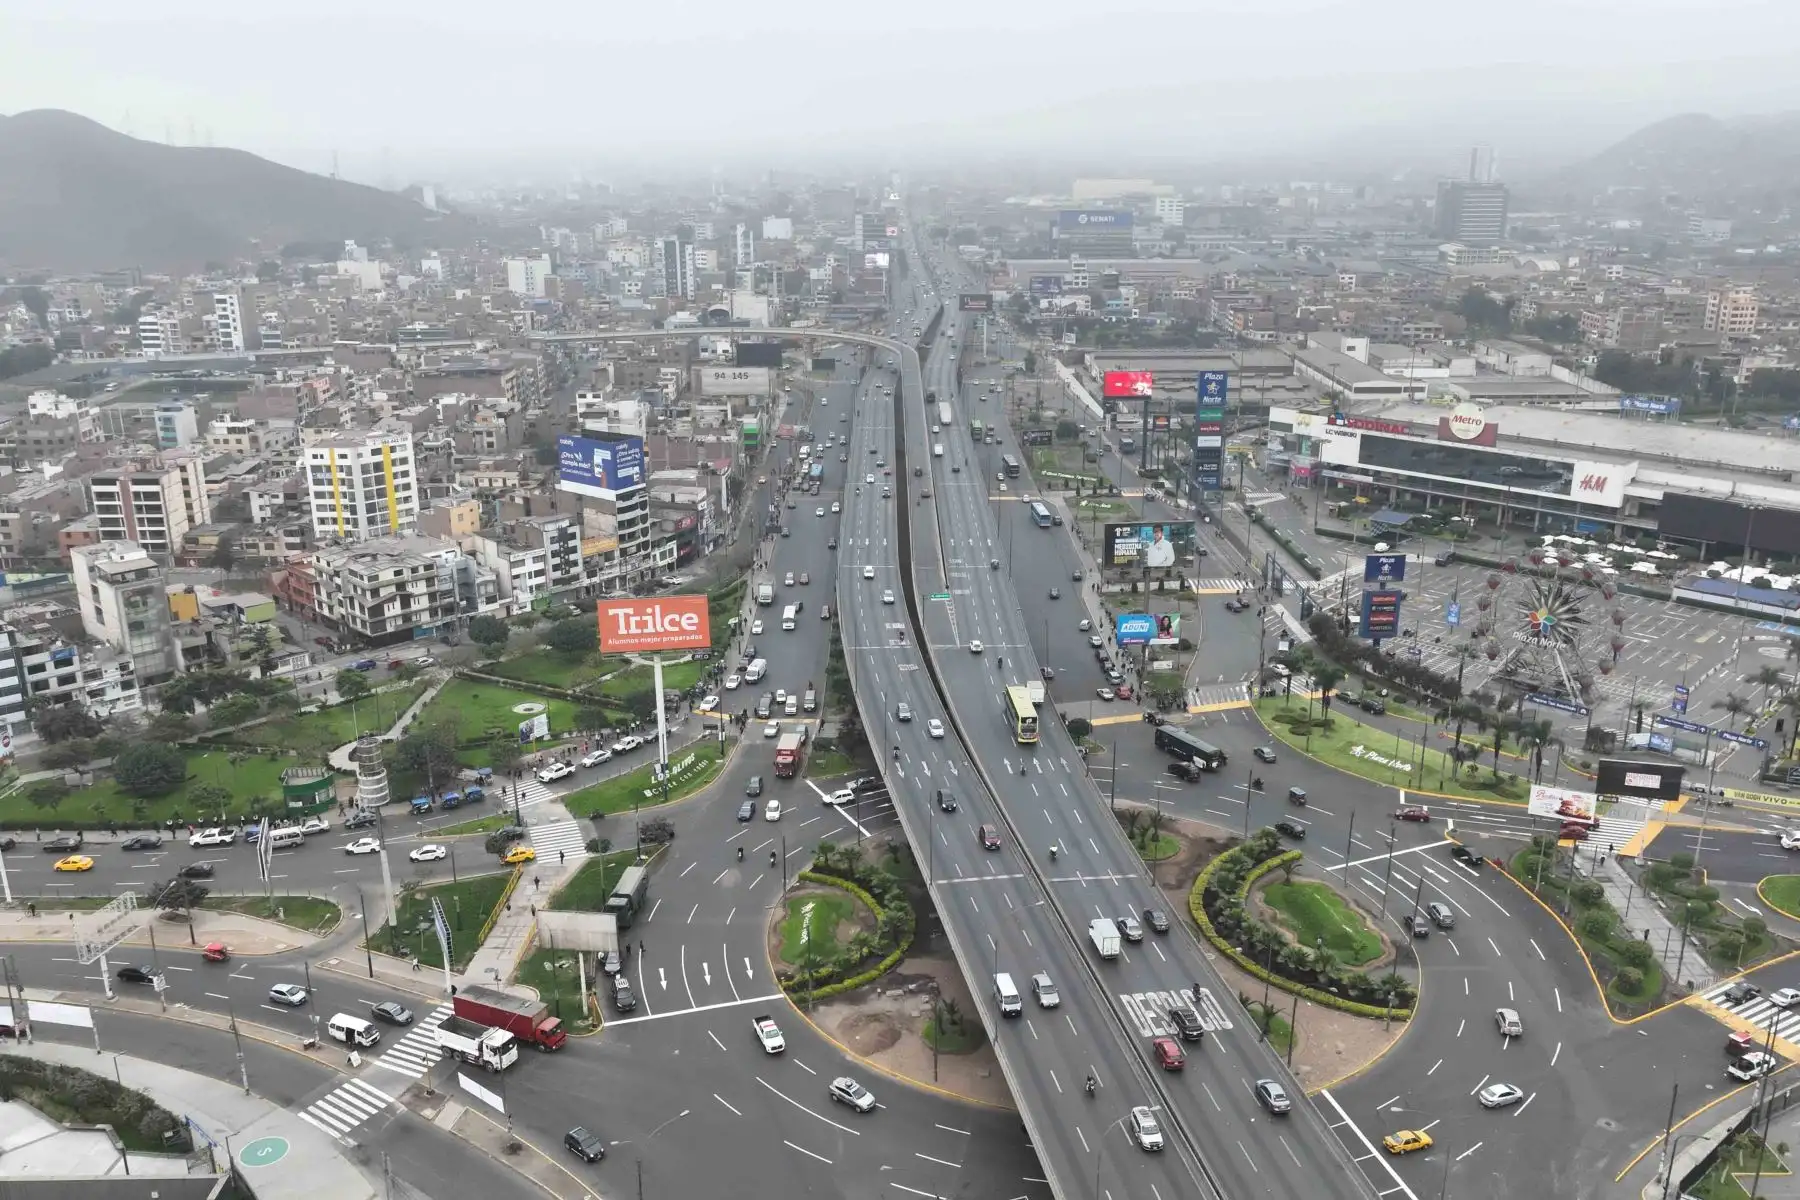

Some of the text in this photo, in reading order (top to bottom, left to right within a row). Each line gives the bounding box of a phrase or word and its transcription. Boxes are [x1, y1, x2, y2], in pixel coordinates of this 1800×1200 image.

[1202, 396, 1222, 404] Norte
[1452, 415, 1482, 426] Metro
[1579, 474, 1608, 493] H&M
[608, 604, 699, 635] Trilce
[1123, 623, 1149, 632] ADUNI
[608, 634, 703, 645] Alumnos mejor preparados
[1512, 631, 1568, 649] Plaza Norte
[1763, 795, 1788, 804] VIVO
